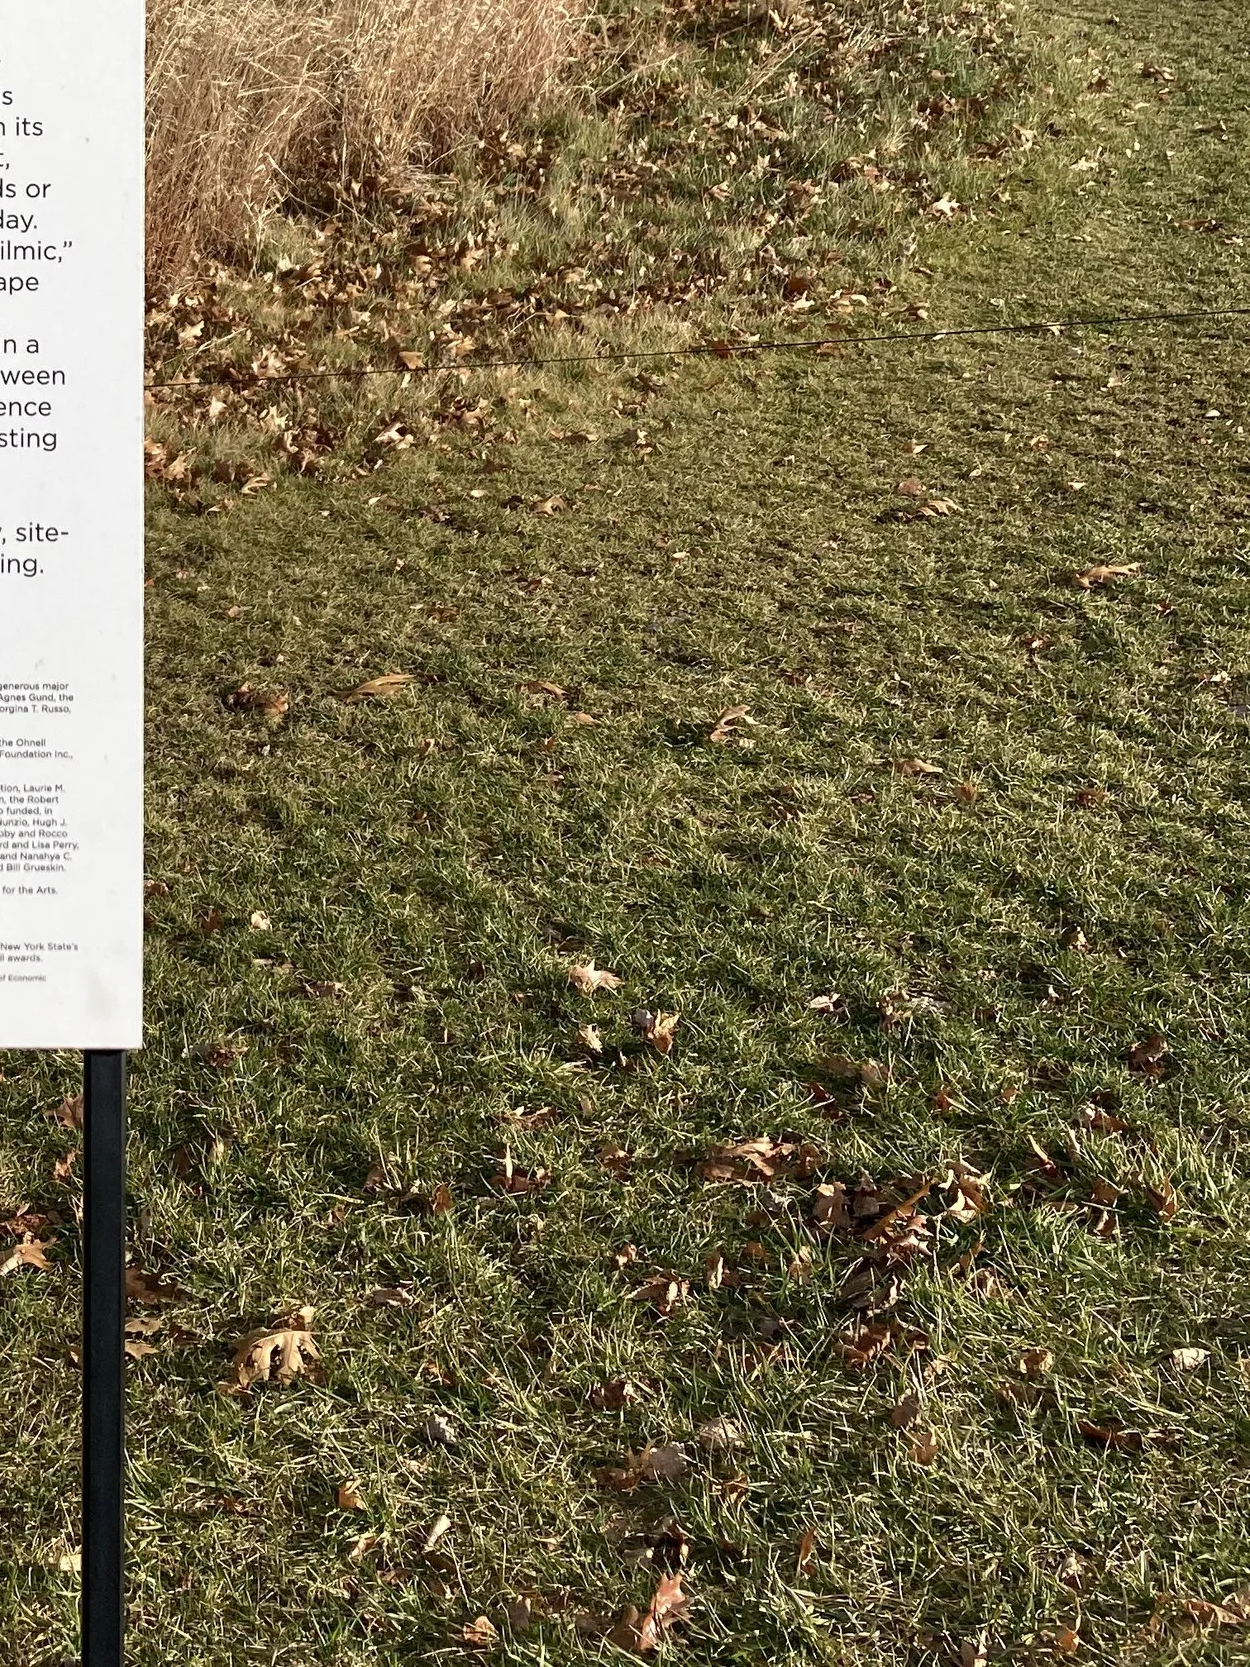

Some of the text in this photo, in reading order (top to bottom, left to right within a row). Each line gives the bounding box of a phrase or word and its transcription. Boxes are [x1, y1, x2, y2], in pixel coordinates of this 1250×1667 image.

[15, 116, 44, 137] its
[15, 521, 70, 543] site-
[42, 681, 70, 692] major
[1, 885, 16, 895] for
[17, 885, 34, 895] the
[35, 885, 59, 895] Arts.
